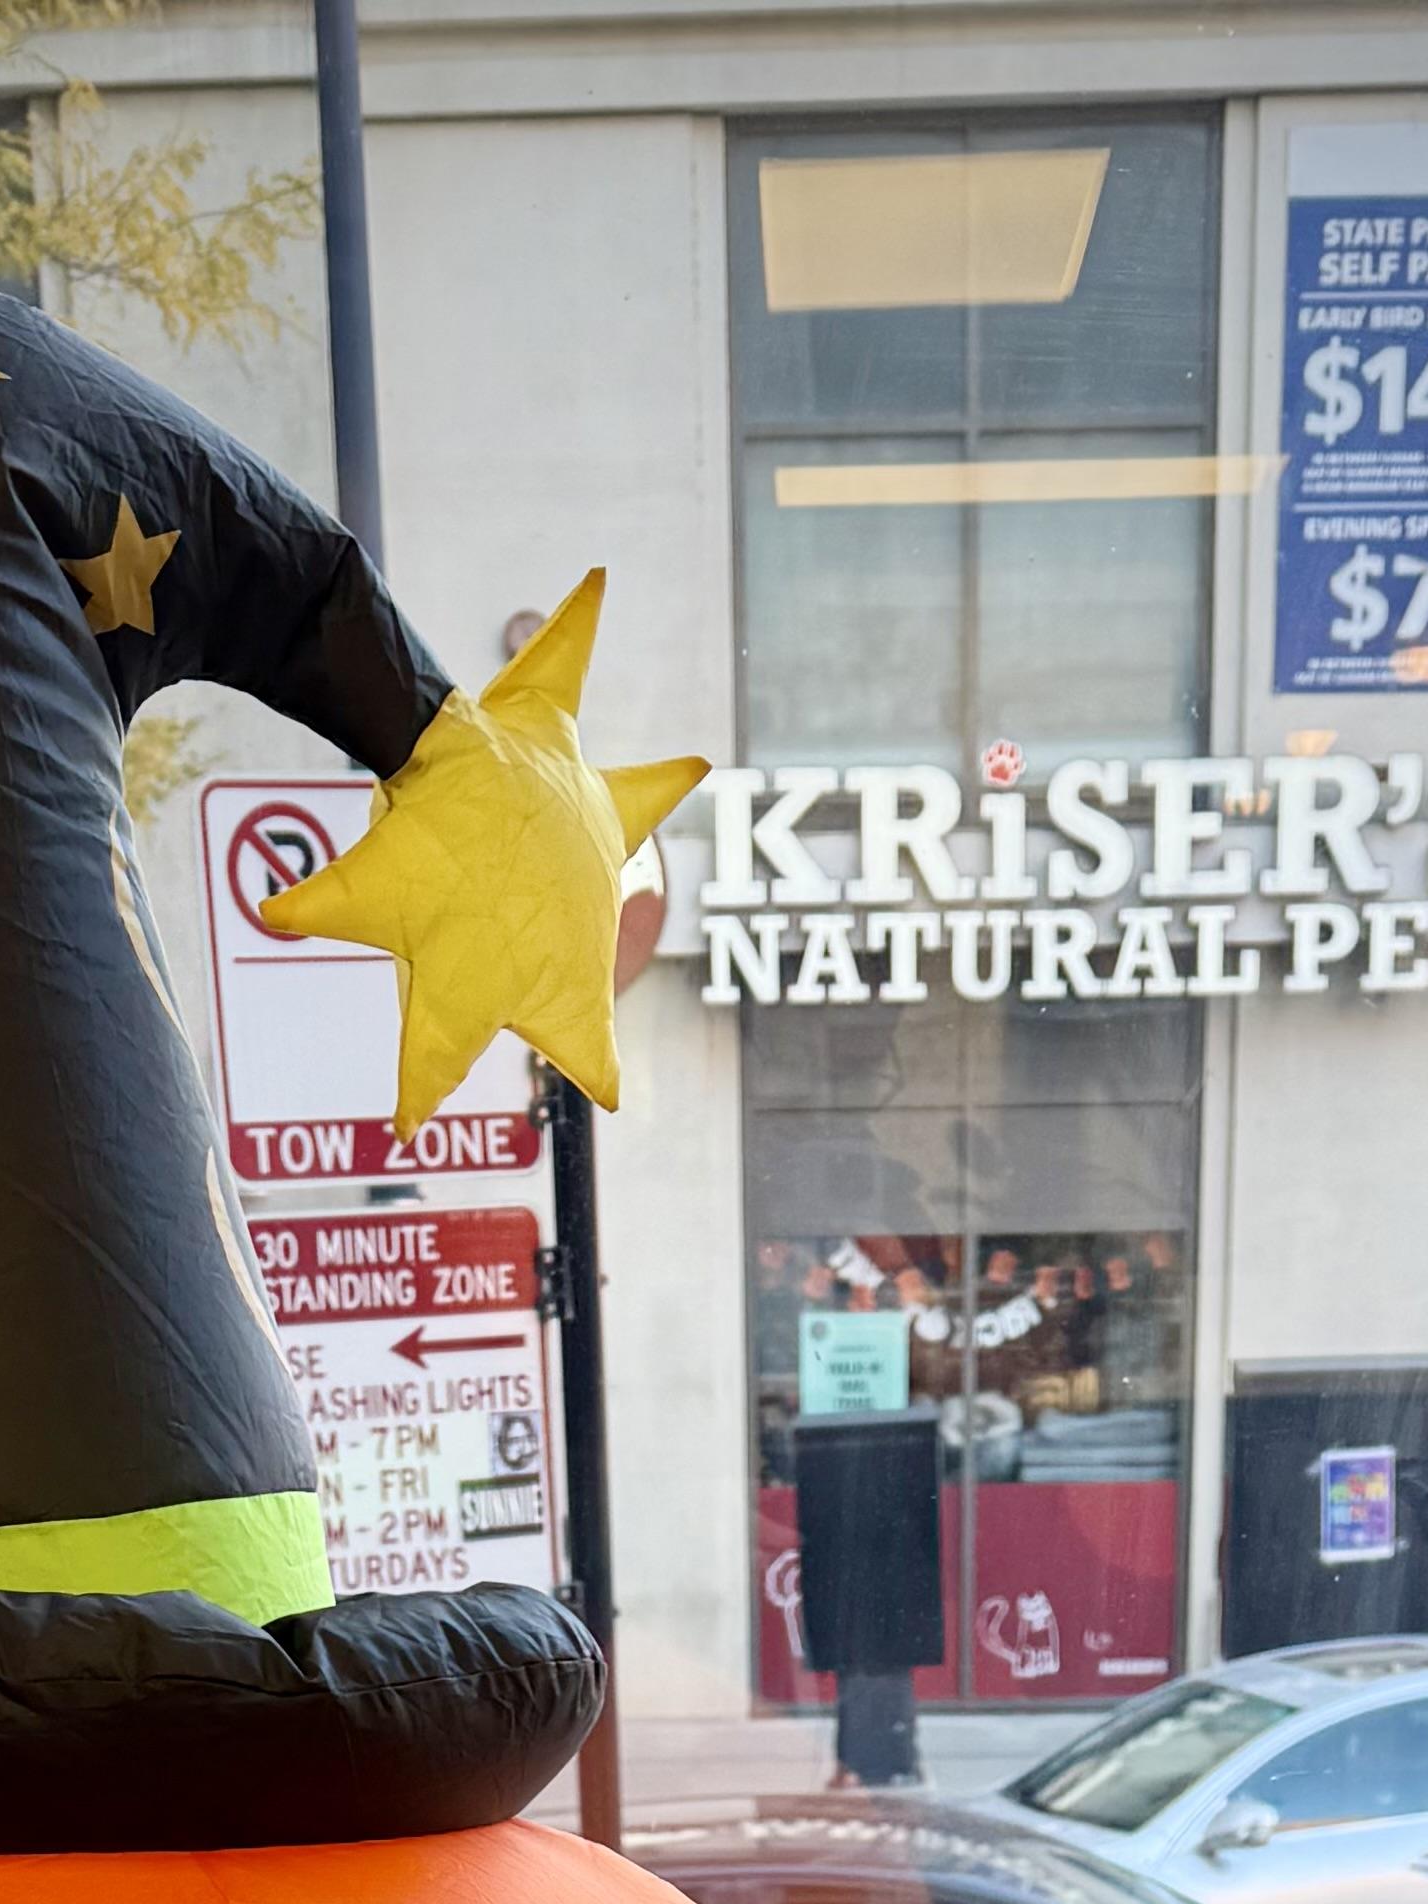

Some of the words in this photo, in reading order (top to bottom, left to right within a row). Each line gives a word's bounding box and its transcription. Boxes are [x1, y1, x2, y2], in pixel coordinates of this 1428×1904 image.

[1323, 218, 1405, 247] STATE
[1319, 251, 1400, 287] SELF
[1298, 307, 1368, 331] EARLY
[1370, 306, 1424, 329] BIRD
[1303, 516, 1403, 541] EVENING
[701, 904, 1261, 1005] NATURAL
[245, 1122, 356, 1175] TOW
[255, 1231, 299, 1270] 30
[316, 1224, 441, 1267] MINUTE
[432, 1264, 519, 1304] ZONE
[286, 1344, 327, 1381] SE
[307, 1381, 420, 1423] ASHING
[426, 1374, 533, 1415] LIGHTS
[379, 1466, 430, 1504] FRI
